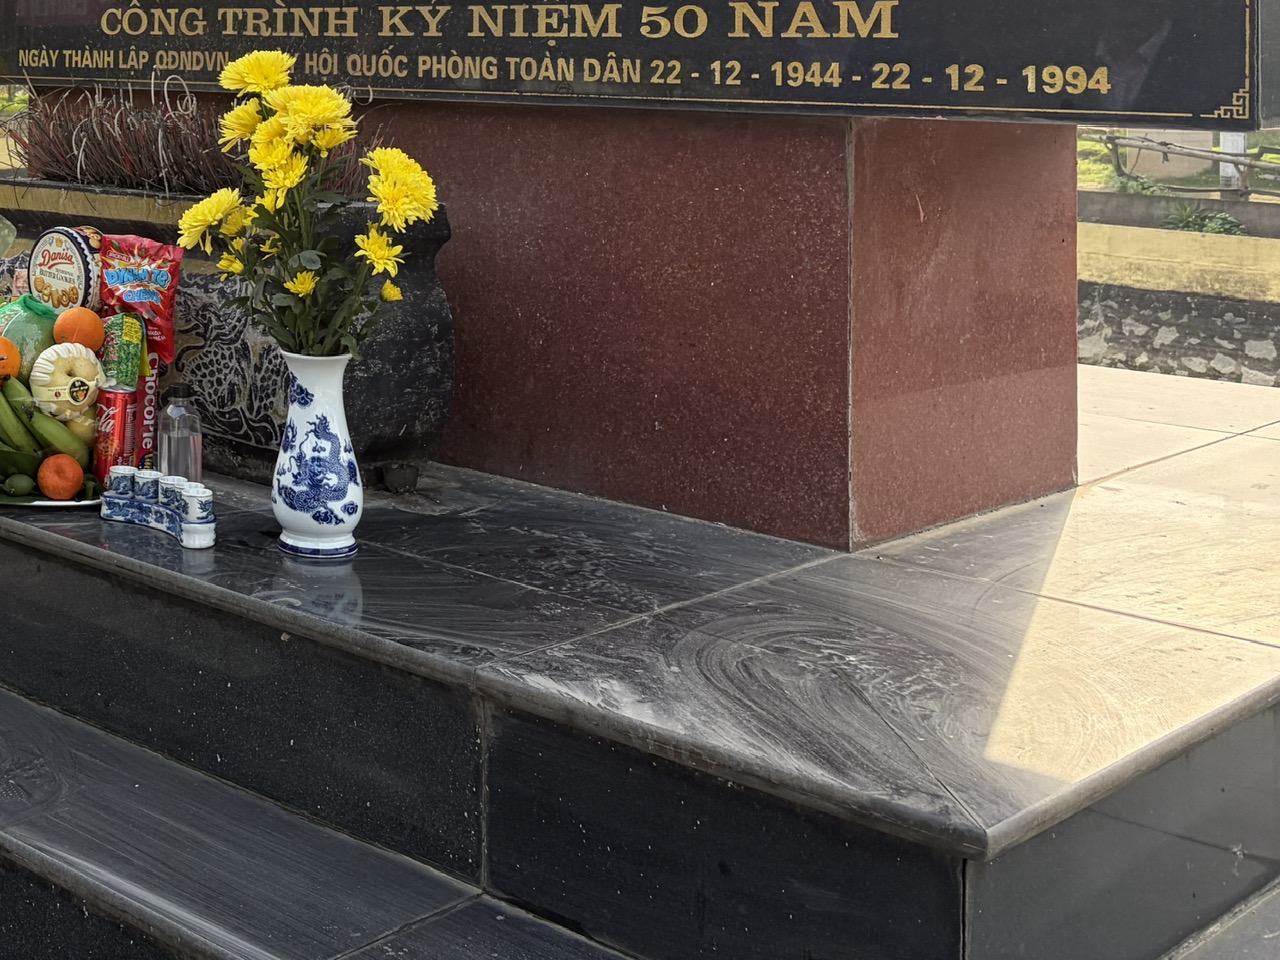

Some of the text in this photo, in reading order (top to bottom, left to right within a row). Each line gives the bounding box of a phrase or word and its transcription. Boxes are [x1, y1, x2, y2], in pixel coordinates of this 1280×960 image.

[100, 0, 207, 37] CÔNG
[639, 4, 709, 38] 50
[18, 44, 60, 69] NGÀY
[63, 44, 114, 69] THÀNH
[119, 45, 150, 75] LẬP
[305, 47, 339, 81] HỘI
[346, 44, 408, 78] QUỐC
[418, 49, 498, 80] PHÒNG
[506, 51, 574, 82] TOÀN
[583, 51, 641, 84] DÂN
[649, 59, 682, 85] 22
[710, 59, 742, 86] 12
[771, 61, 843, 88] 1944
[871, 62, 912, 90] 22
[945, 63, 985, 91] 12
[996, 77, 1008, 85] -
[1022, 65, 1111, 95] 1994
[38, 248, 75, 269] Danisa
